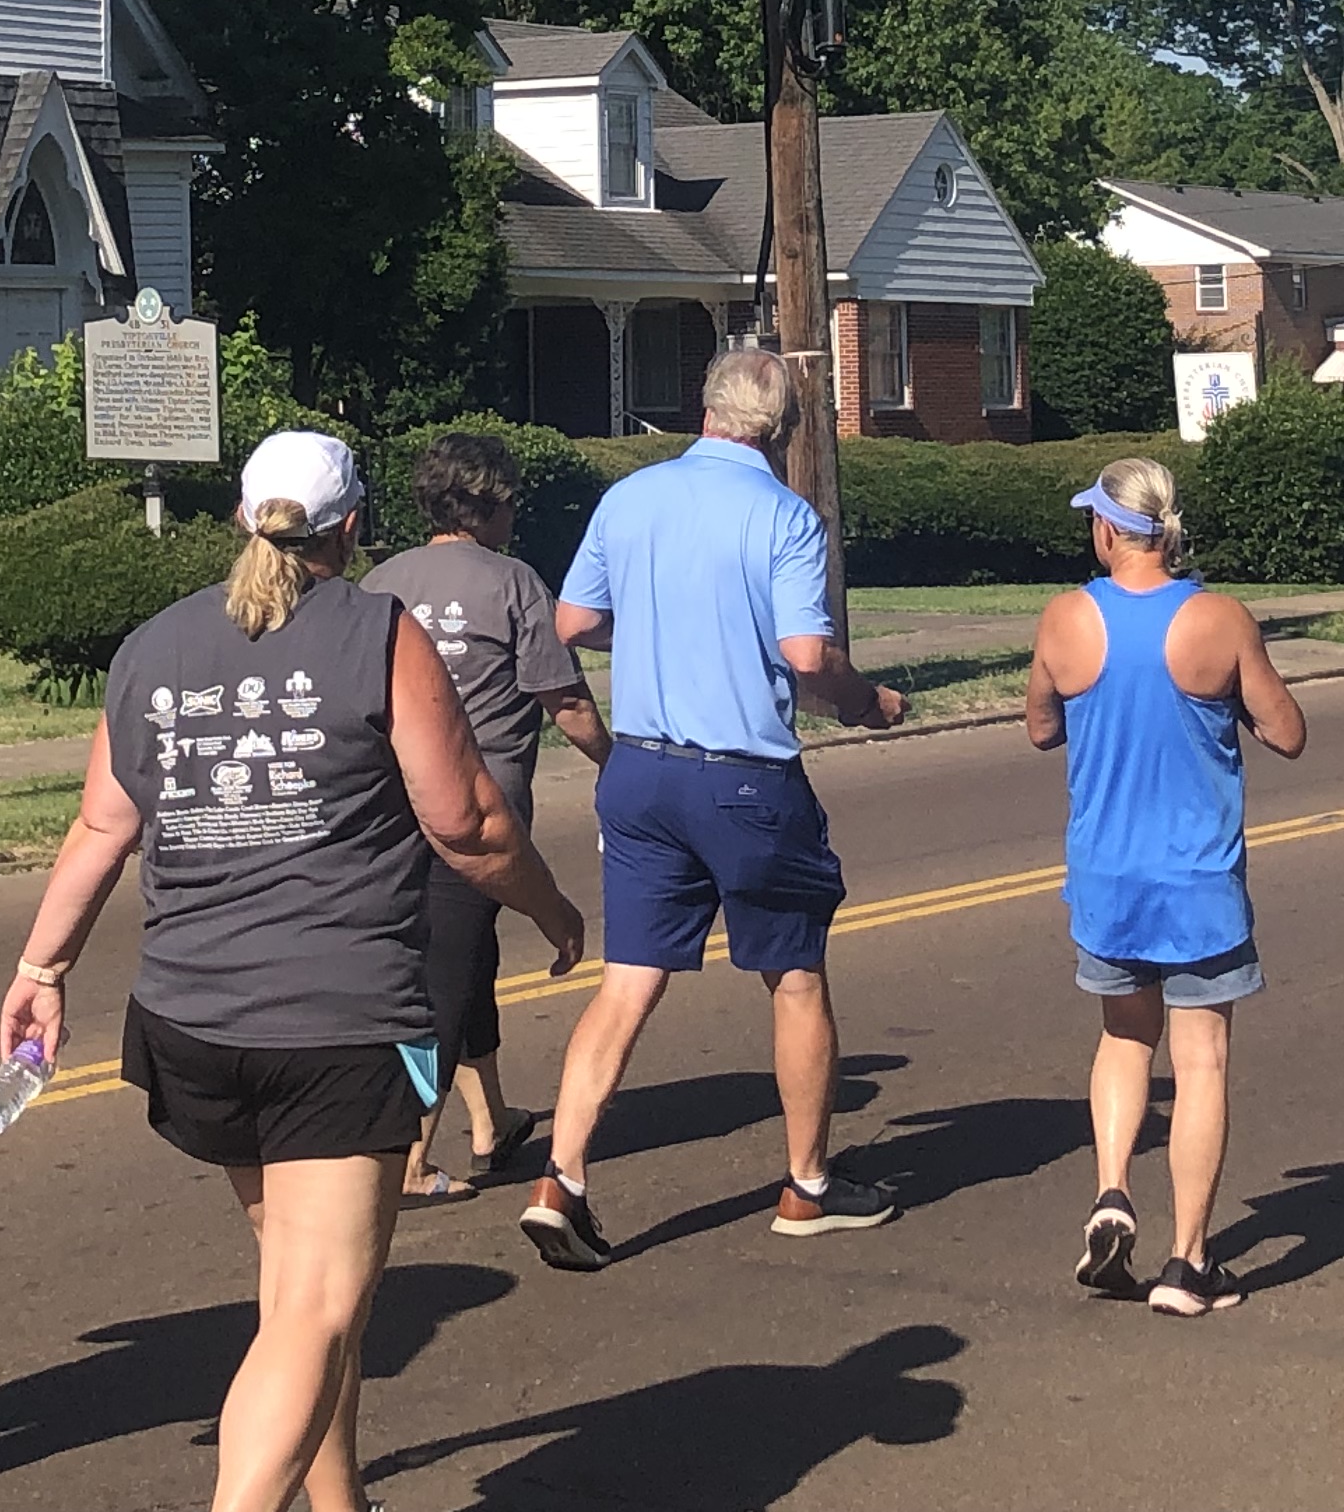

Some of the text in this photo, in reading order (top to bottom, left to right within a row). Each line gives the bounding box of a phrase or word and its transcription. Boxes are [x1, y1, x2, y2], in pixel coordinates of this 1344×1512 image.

[101, 340, 199, 349] PRESBYTERIAN CHURCH
[1183, 362, 1230, 417] PRESBYTERIAN
